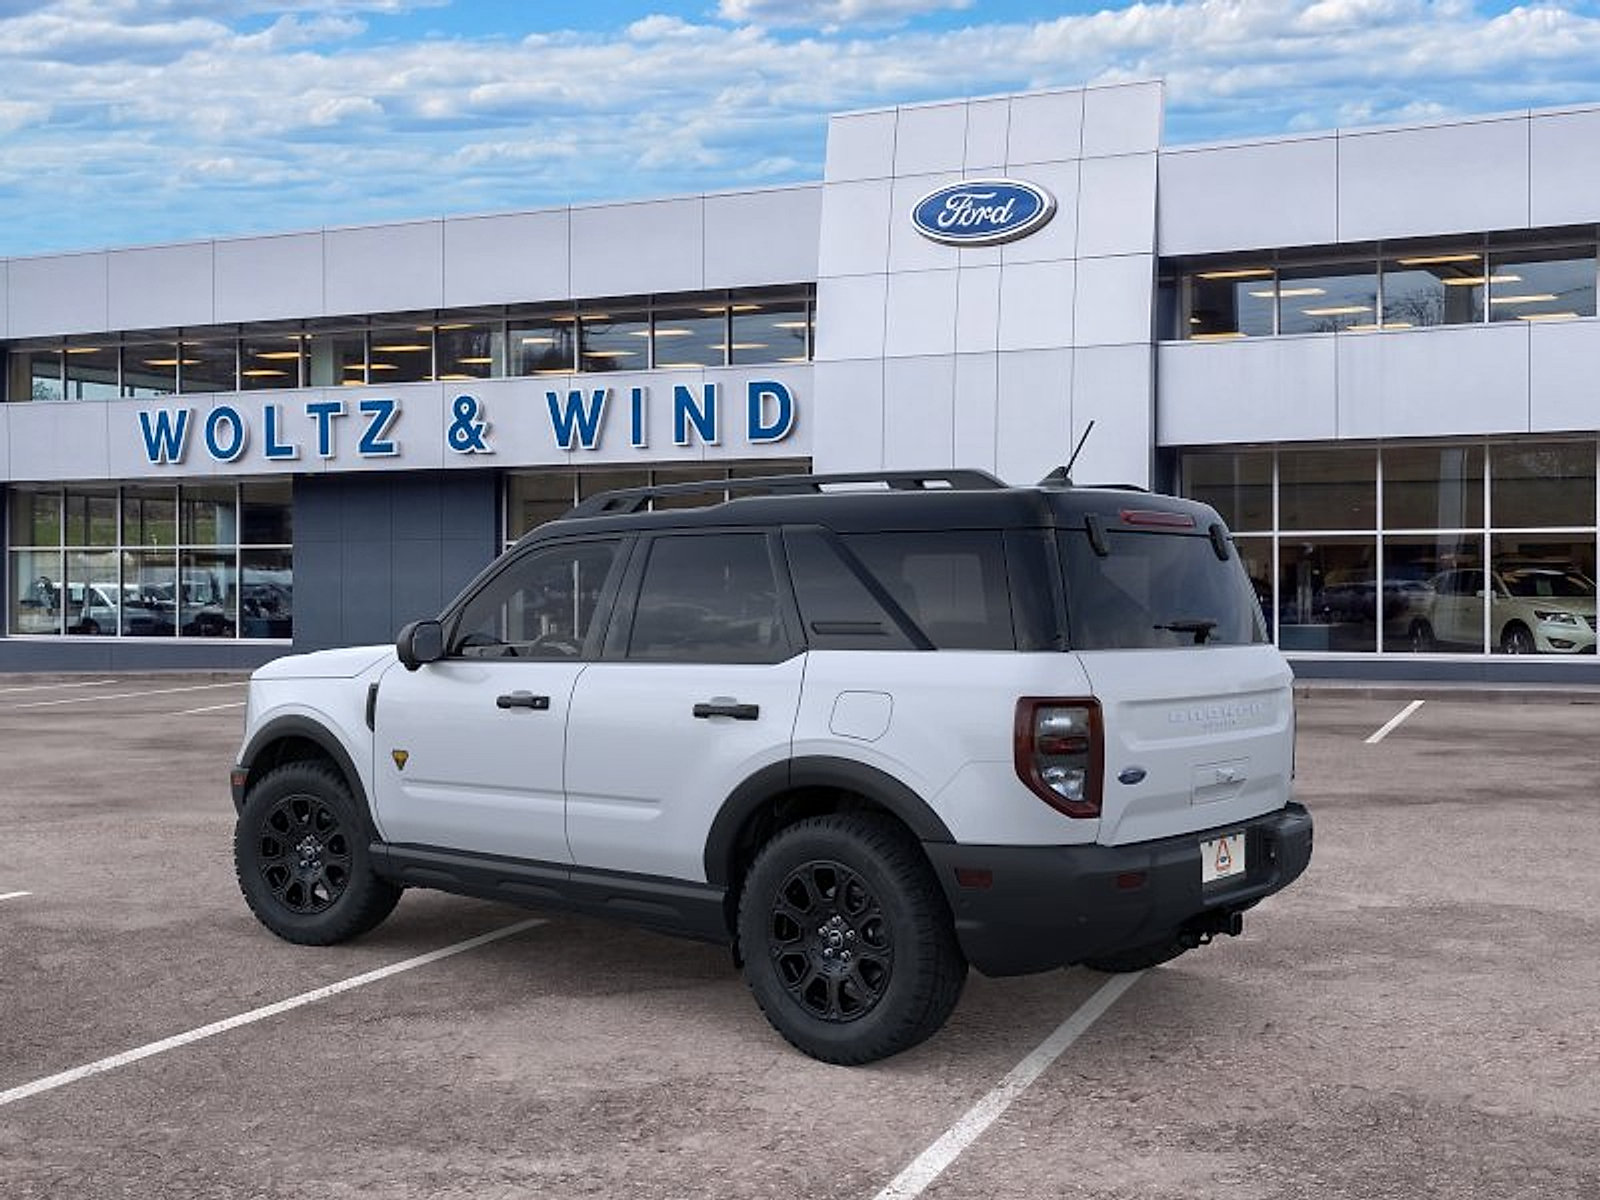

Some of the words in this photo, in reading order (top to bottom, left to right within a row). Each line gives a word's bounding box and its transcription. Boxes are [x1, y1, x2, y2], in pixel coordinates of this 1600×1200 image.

[937, 192, 1015, 228] Ford
[138, 399, 399, 464] WOLTZ
[447, 394, 492, 454] &
[546, 380, 795, 449] WIND
